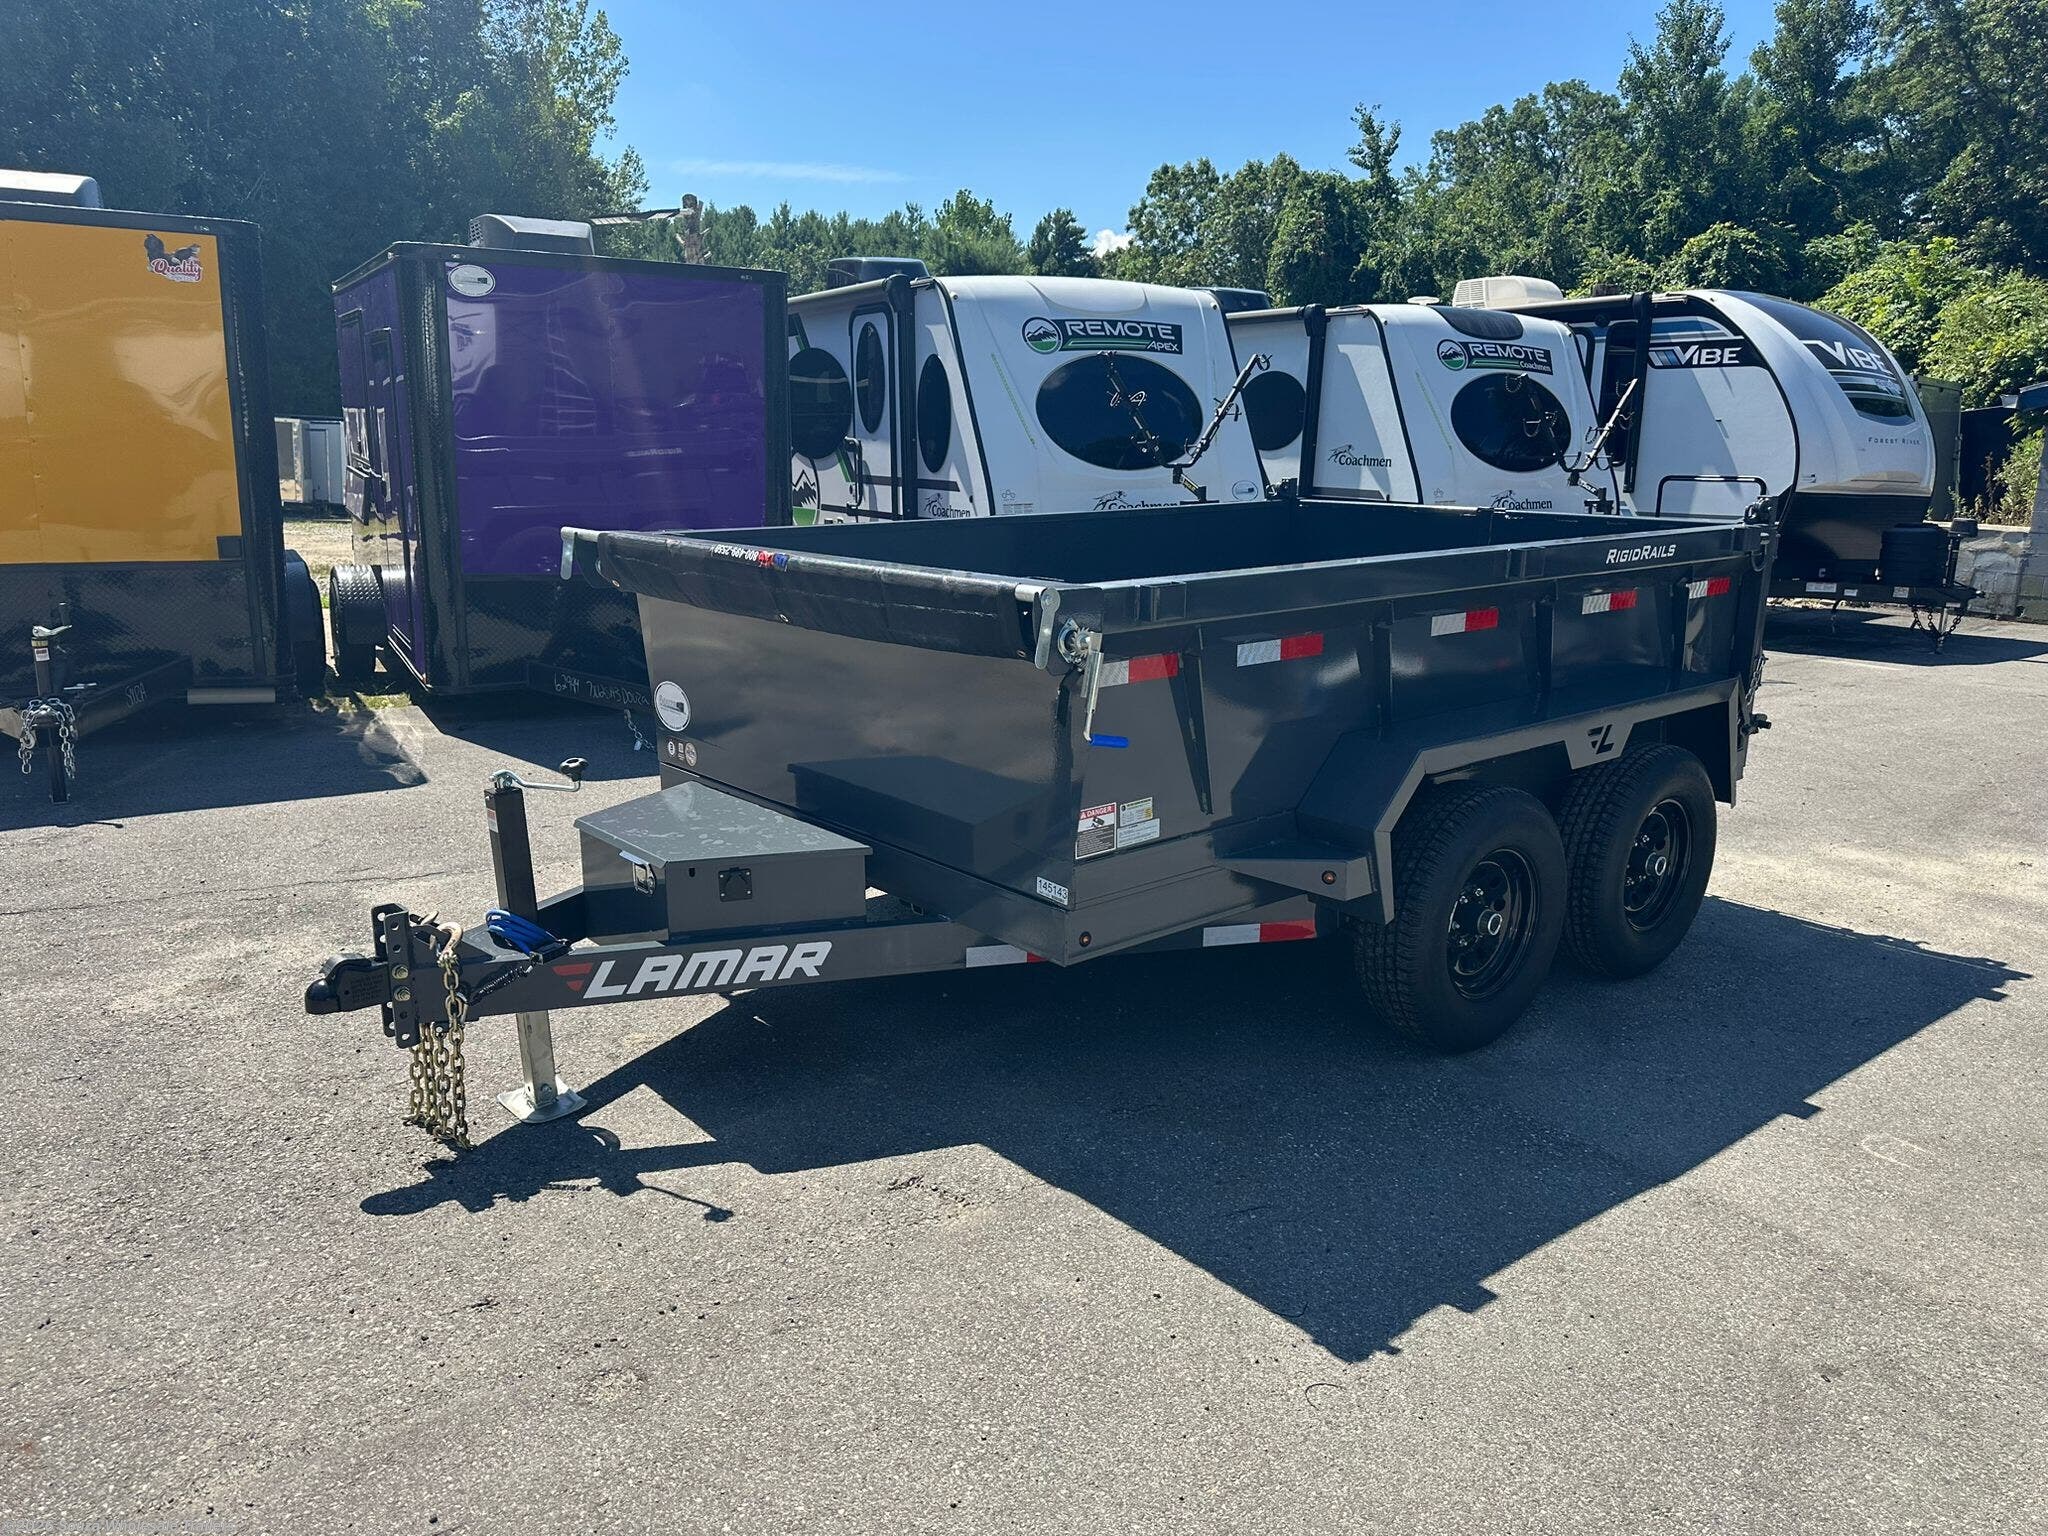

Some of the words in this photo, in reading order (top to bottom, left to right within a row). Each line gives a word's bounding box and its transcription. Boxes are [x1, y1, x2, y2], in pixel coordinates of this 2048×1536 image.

[150, 258, 202, 282] Quality
[1065, 320, 1176, 340] REMOTE
[1146, 340, 1180, 352] APEX
[1468, 343, 1548, 363] REMOTE
[1672, 344, 1743, 365] VIBE
[1816, 339, 1894, 375] VIBE
[1519, 360, 1552, 372] Coachmen
[1868, 436, 1899, 444] FOREST
[1339, 453, 1393, 468] Coachmen
[932, 503, 971, 518] Coachmen
[1501, 497, 1553, 511] Coachmen
[1087, 805, 1114, 819] DANGER
[1038, 879, 1068, 900] 145143
[583, 940, 833, 999] LAMAR
